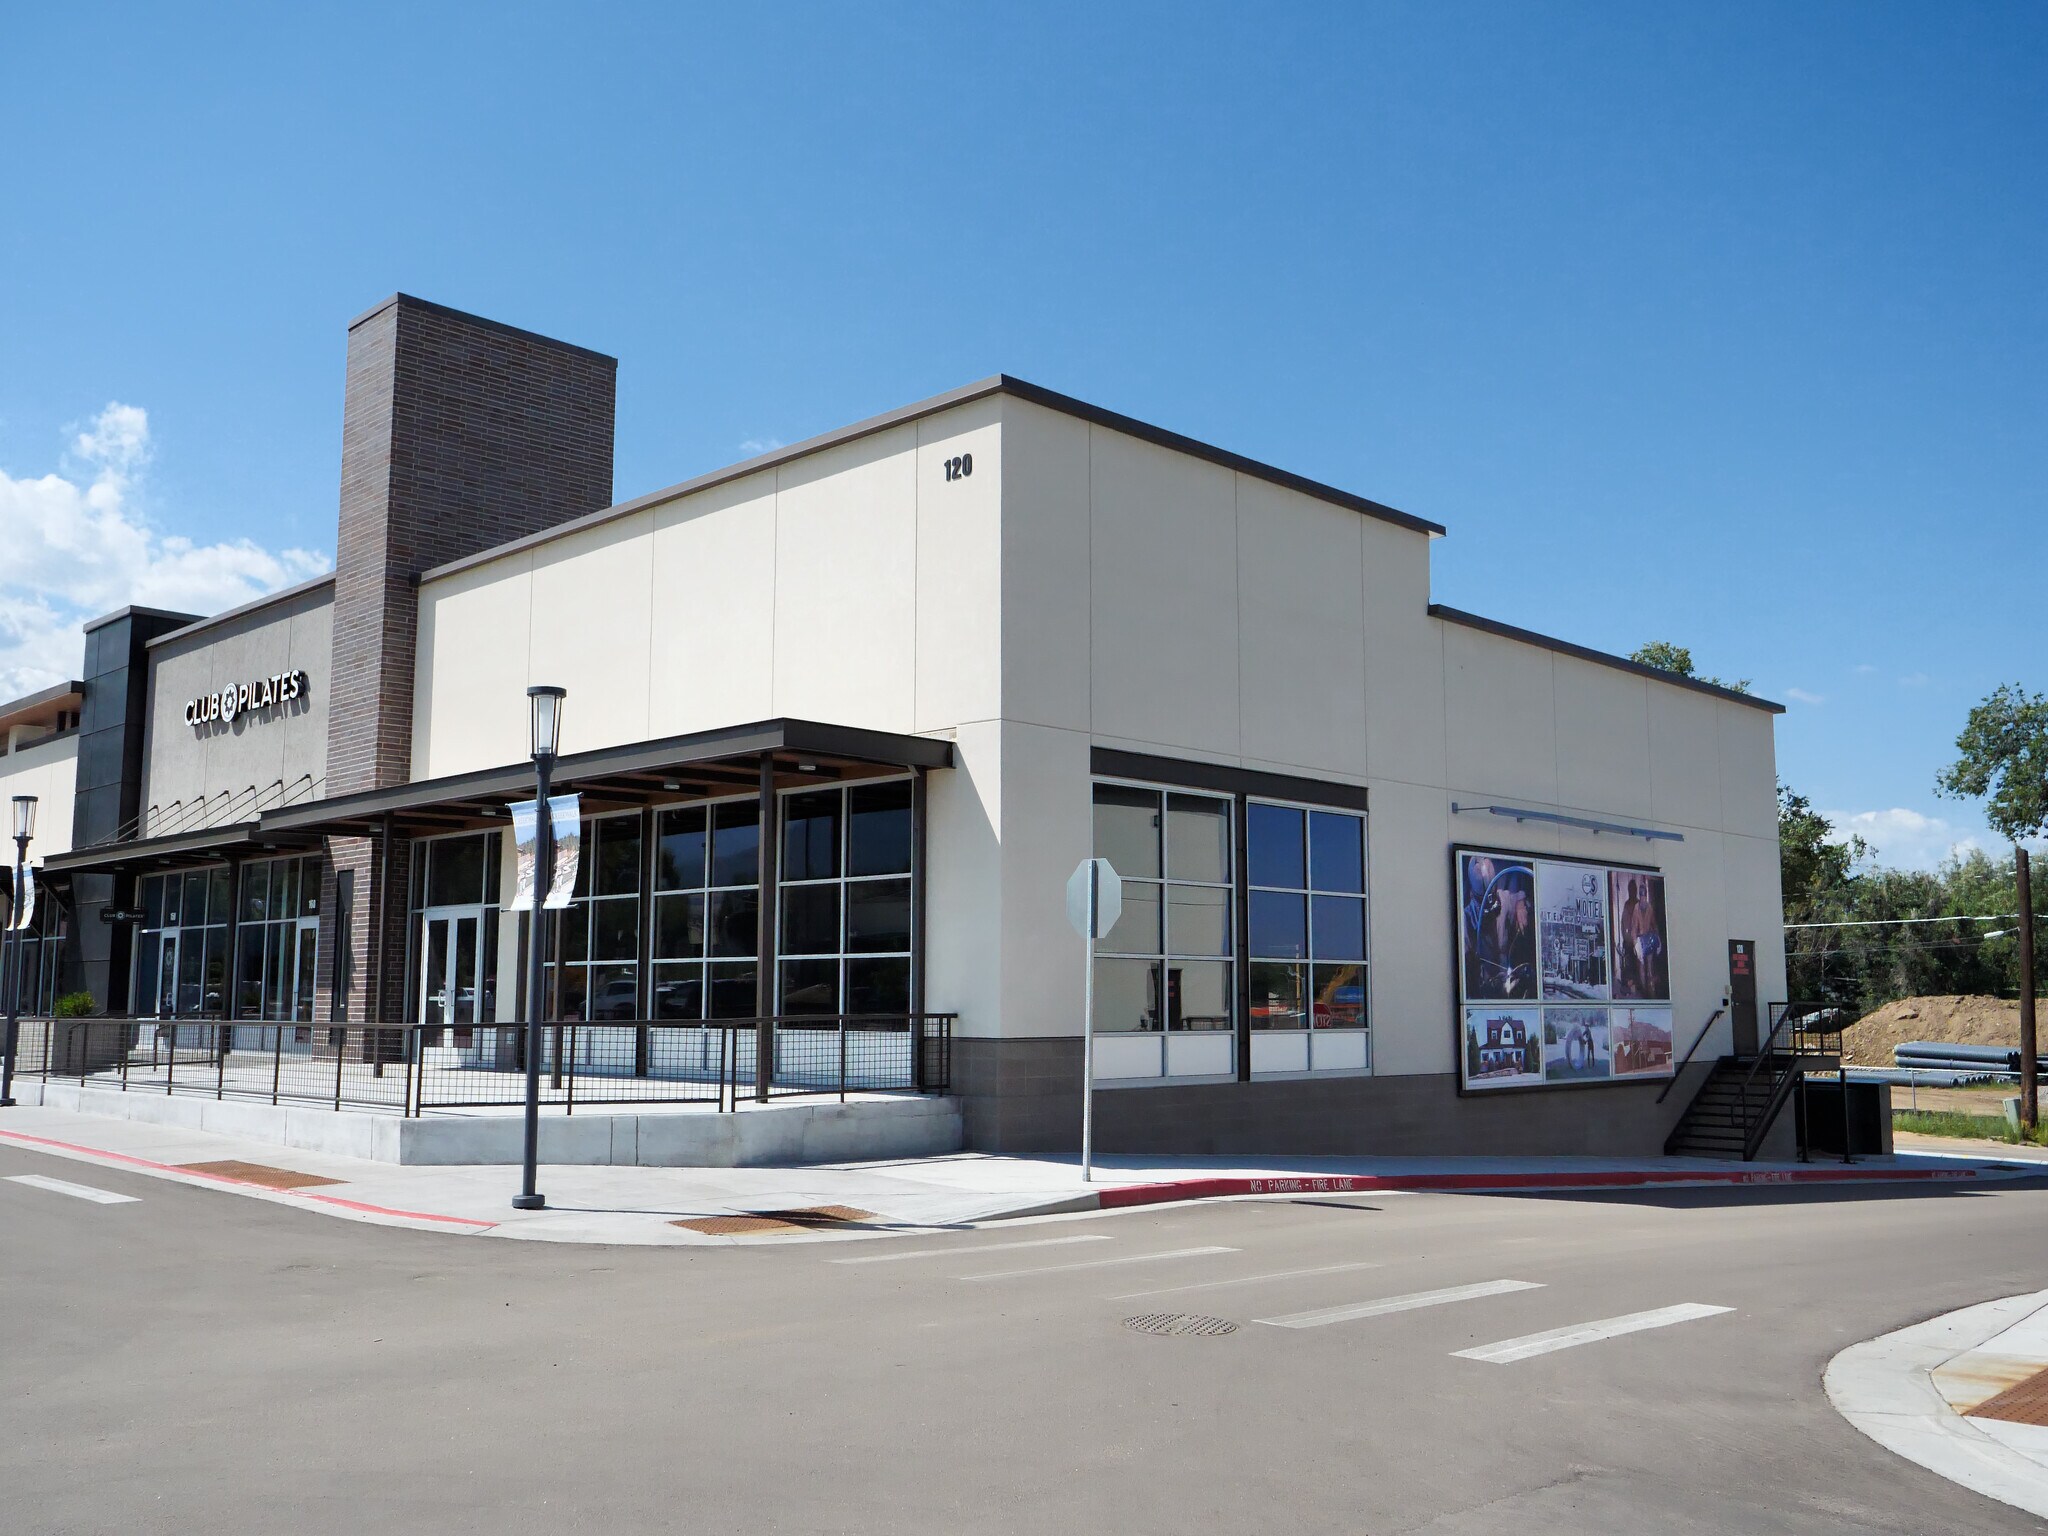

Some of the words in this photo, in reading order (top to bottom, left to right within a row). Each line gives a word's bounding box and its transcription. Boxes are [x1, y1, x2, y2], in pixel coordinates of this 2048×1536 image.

[944, 453, 973, 482] 120
[184, 692, 220, 727] CLUB
[238, 669, 300, 713] PILATES
[1576, 898, 1604, 919] MOTEL
[1250, 1179, 1262, 1192] NO
[1267, 1179, 1302, 1191] PARKING
[1312, 1178, 1330, 1191] FIRE
[1333, 1178, 1354, 1190] LANE
